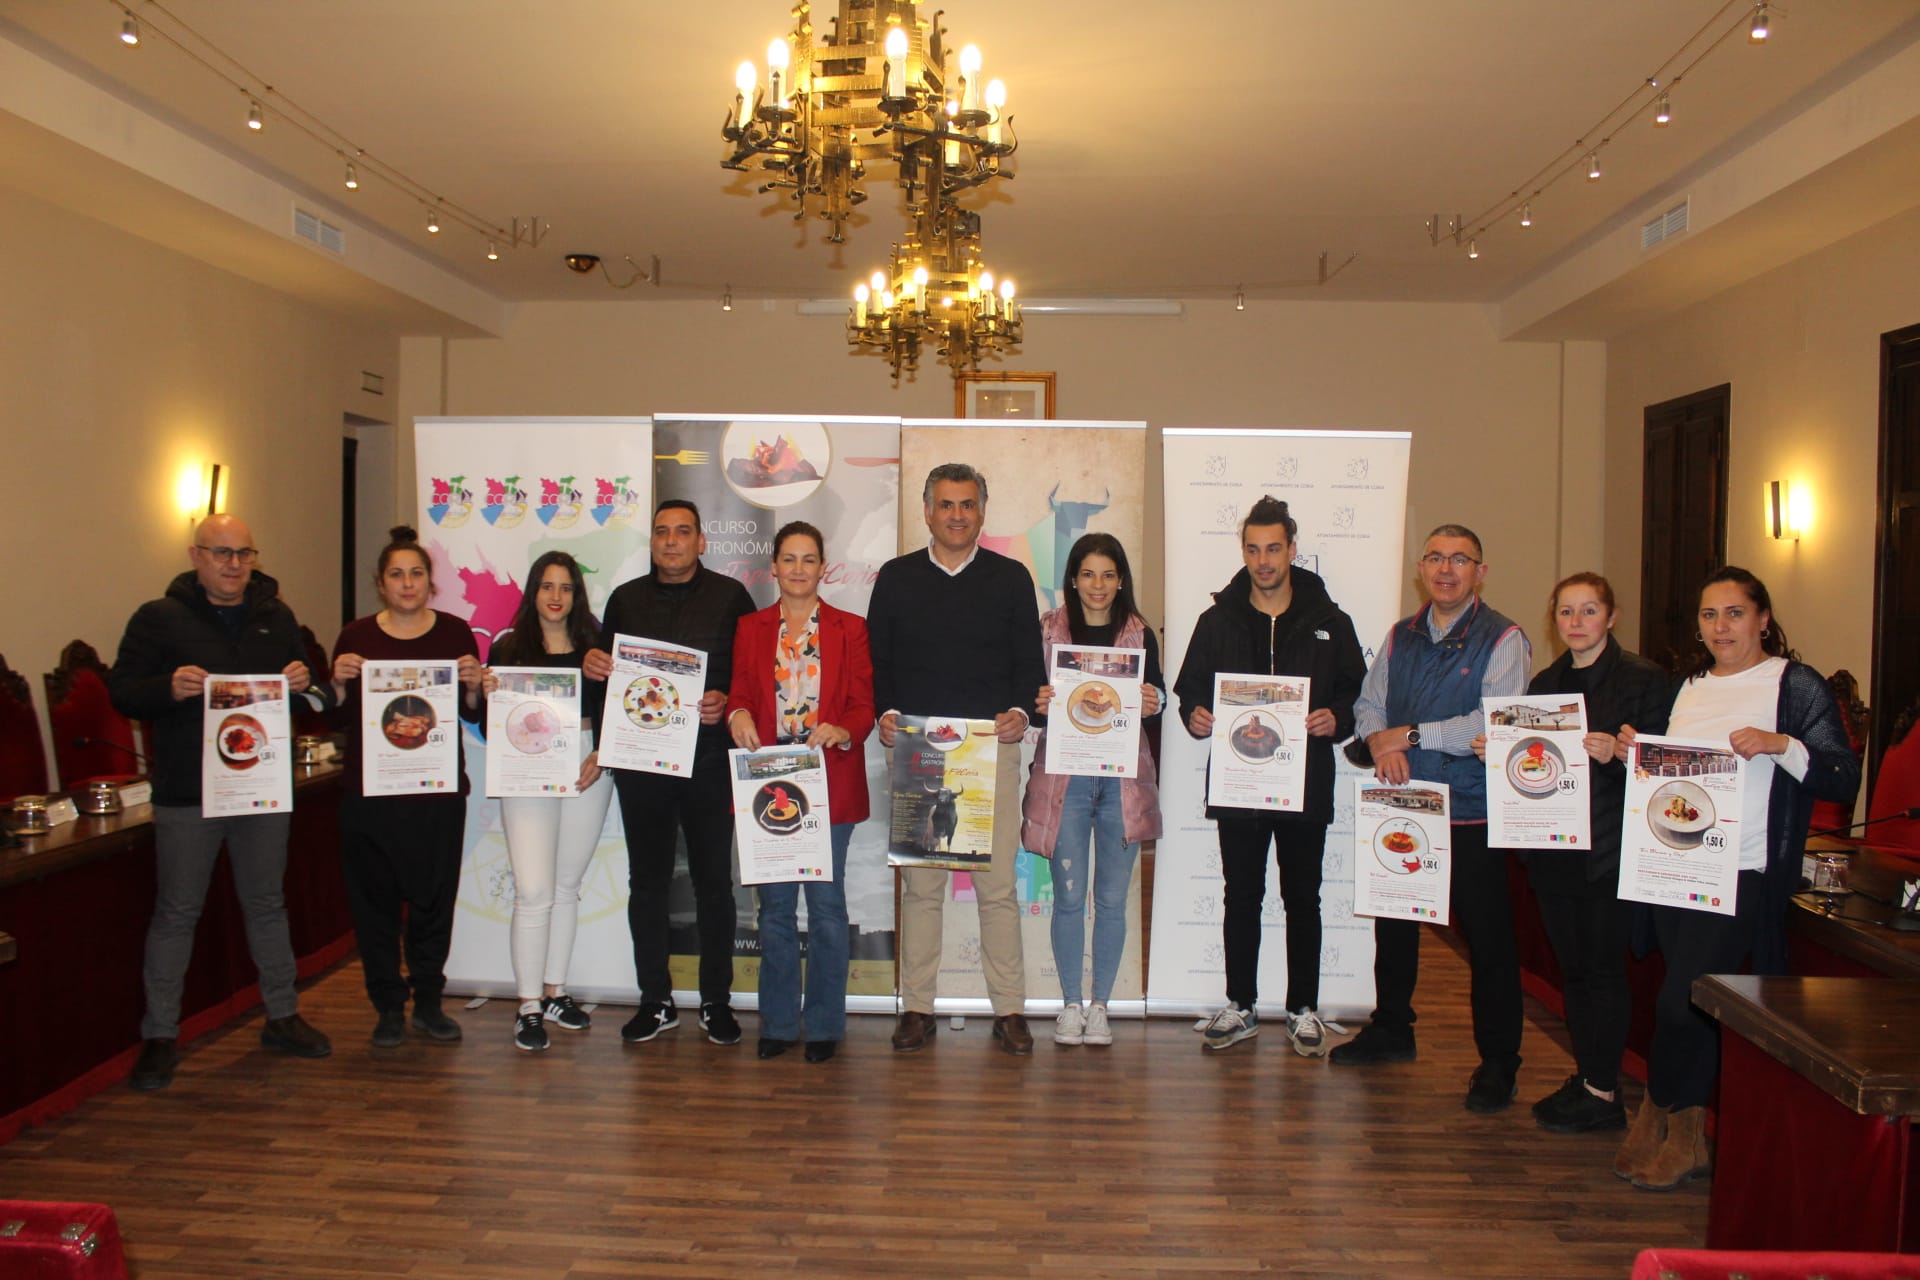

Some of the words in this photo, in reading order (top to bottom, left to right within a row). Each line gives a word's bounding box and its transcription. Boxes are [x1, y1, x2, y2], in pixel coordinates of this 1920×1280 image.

[707, 540, 774, 555] TRONÓMI
[1276, 752, 1287, 761] 1,50
[1559, 780, 1571, 791] 1,50
[1706, 836, 1718, 848] 1,50
[1423, 860, 1433, 870] 1,50
